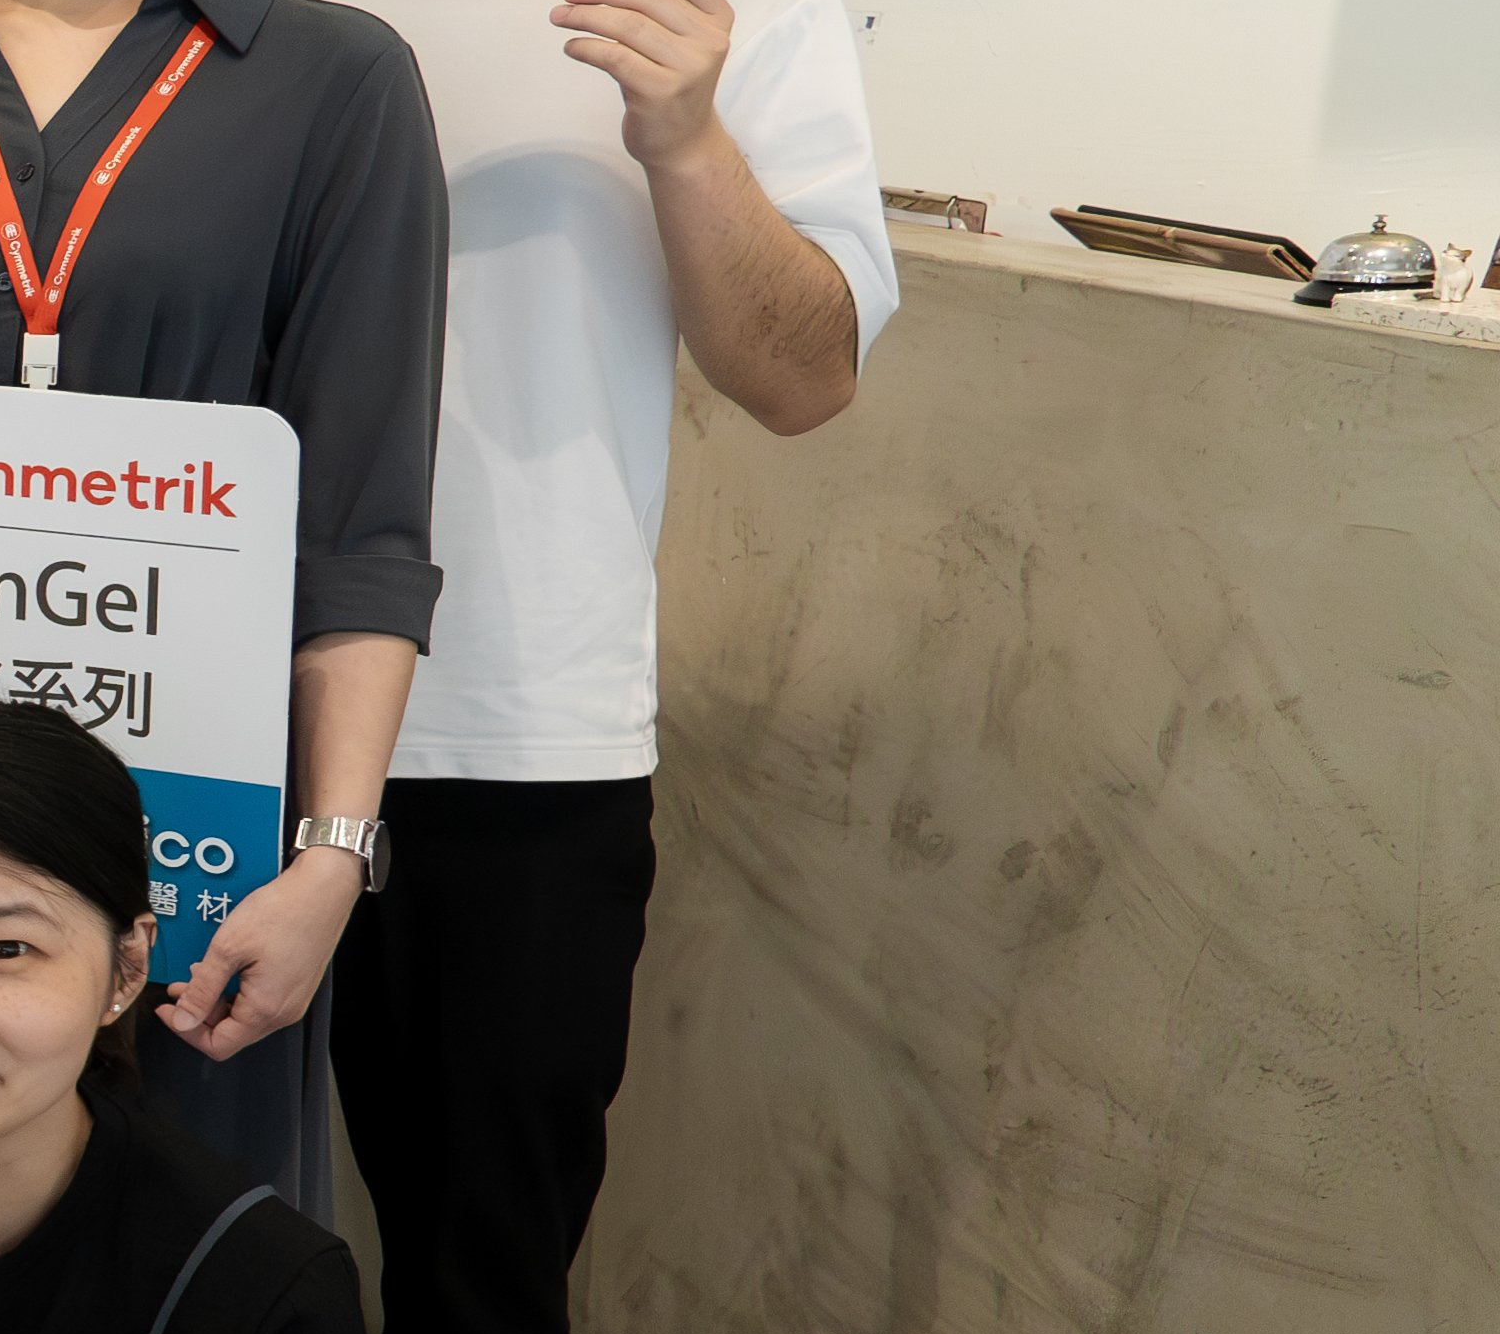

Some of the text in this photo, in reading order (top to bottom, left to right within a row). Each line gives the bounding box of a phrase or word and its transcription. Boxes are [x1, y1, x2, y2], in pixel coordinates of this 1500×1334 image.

[168, 39, 204, 82] Cymmetrik
[105, 125, 141, 170] Cymmetrik
[9, 241, 35, 298] Cymmetrik
[54, 227, 82, 285] Cymmetrik
